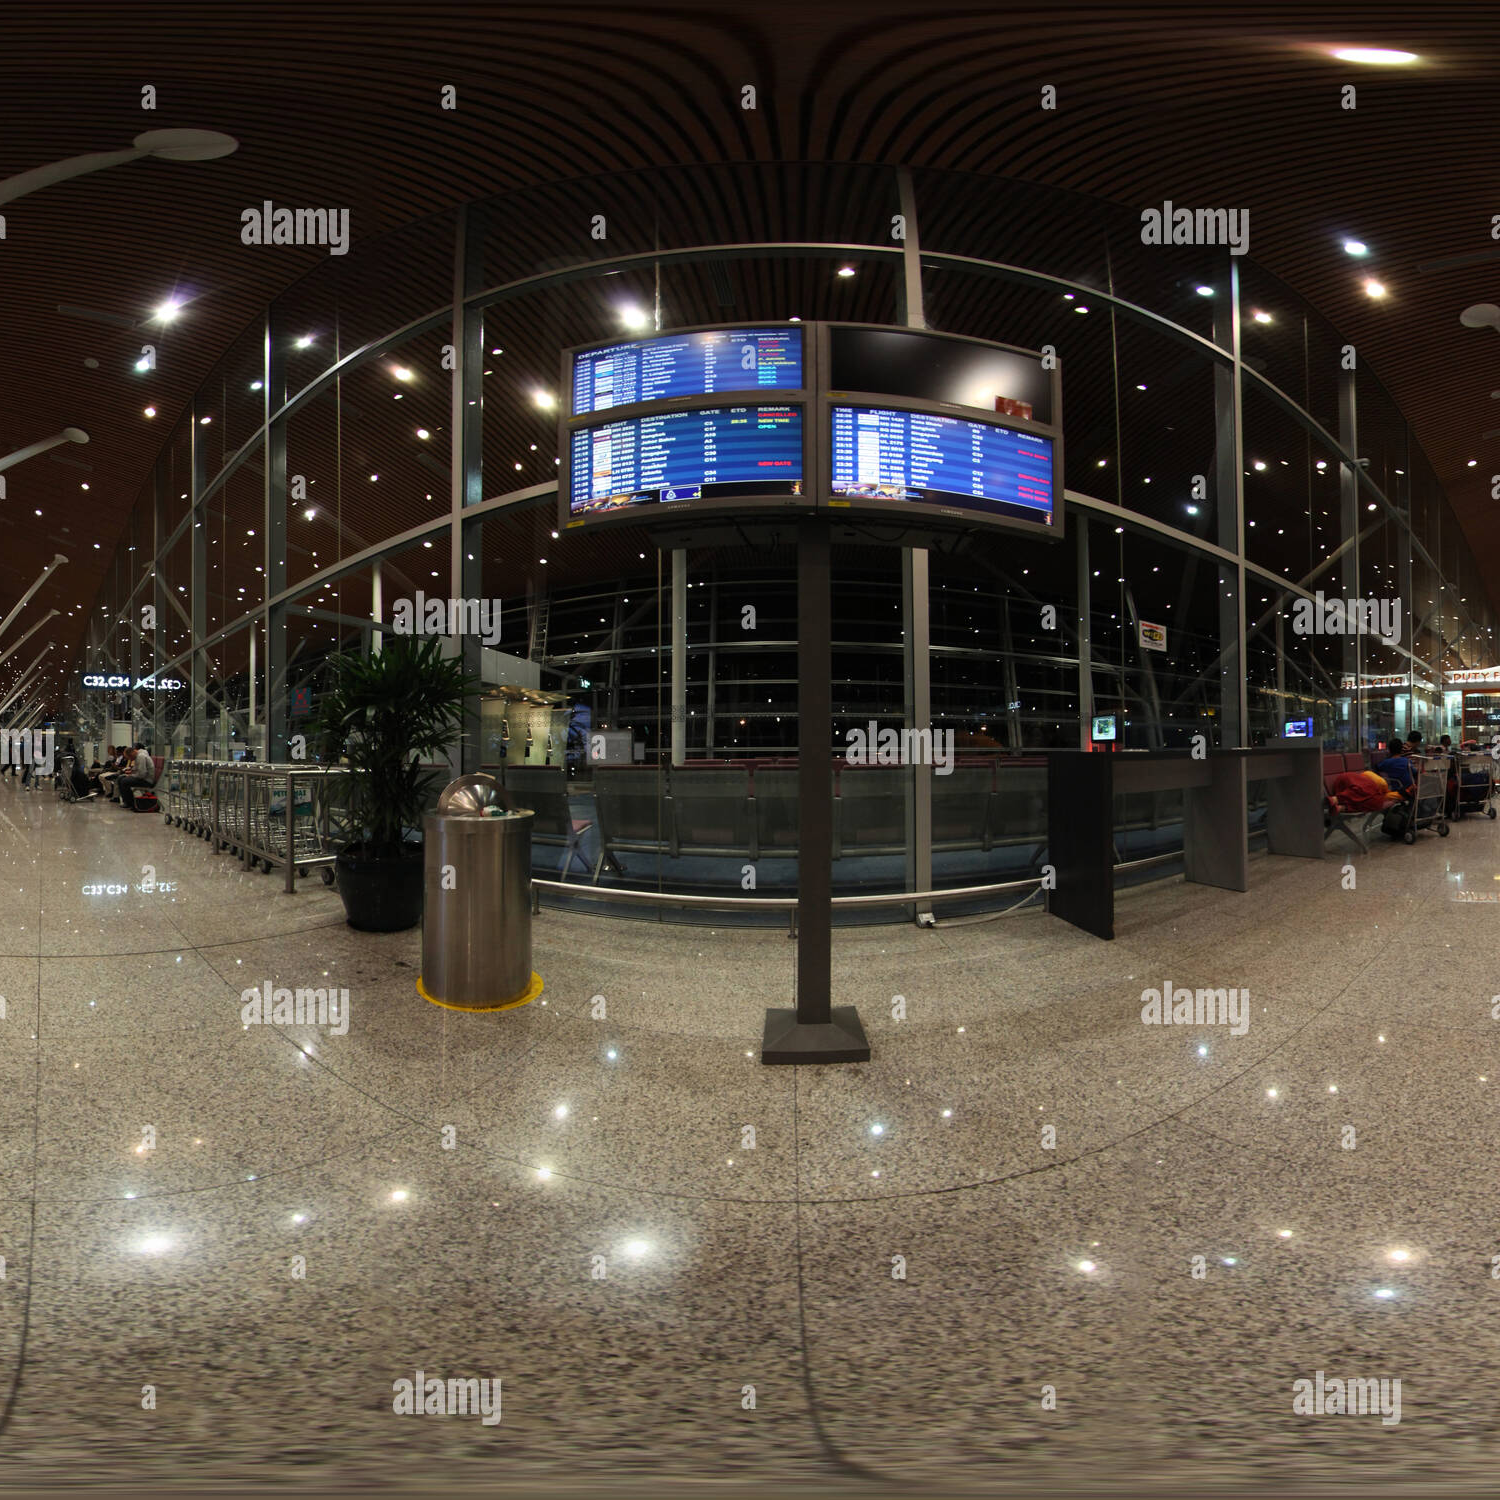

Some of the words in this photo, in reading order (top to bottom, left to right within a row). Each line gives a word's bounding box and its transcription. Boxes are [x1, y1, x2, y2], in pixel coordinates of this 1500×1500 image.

[578, 344, 638, 359] DEPARTURE
[603, 421, 628, 430] FLIGHT
[640, 412, 688, 423] DESTINATION
[869, 409, 897, 417] FLIGHT
[910, 413, 957, 425] DESTINATION
[967, 422, 987, 430] GATE
[1017, 432, 1044, 444] REMARK
[1453, 672, 1490, 681] DUTY
